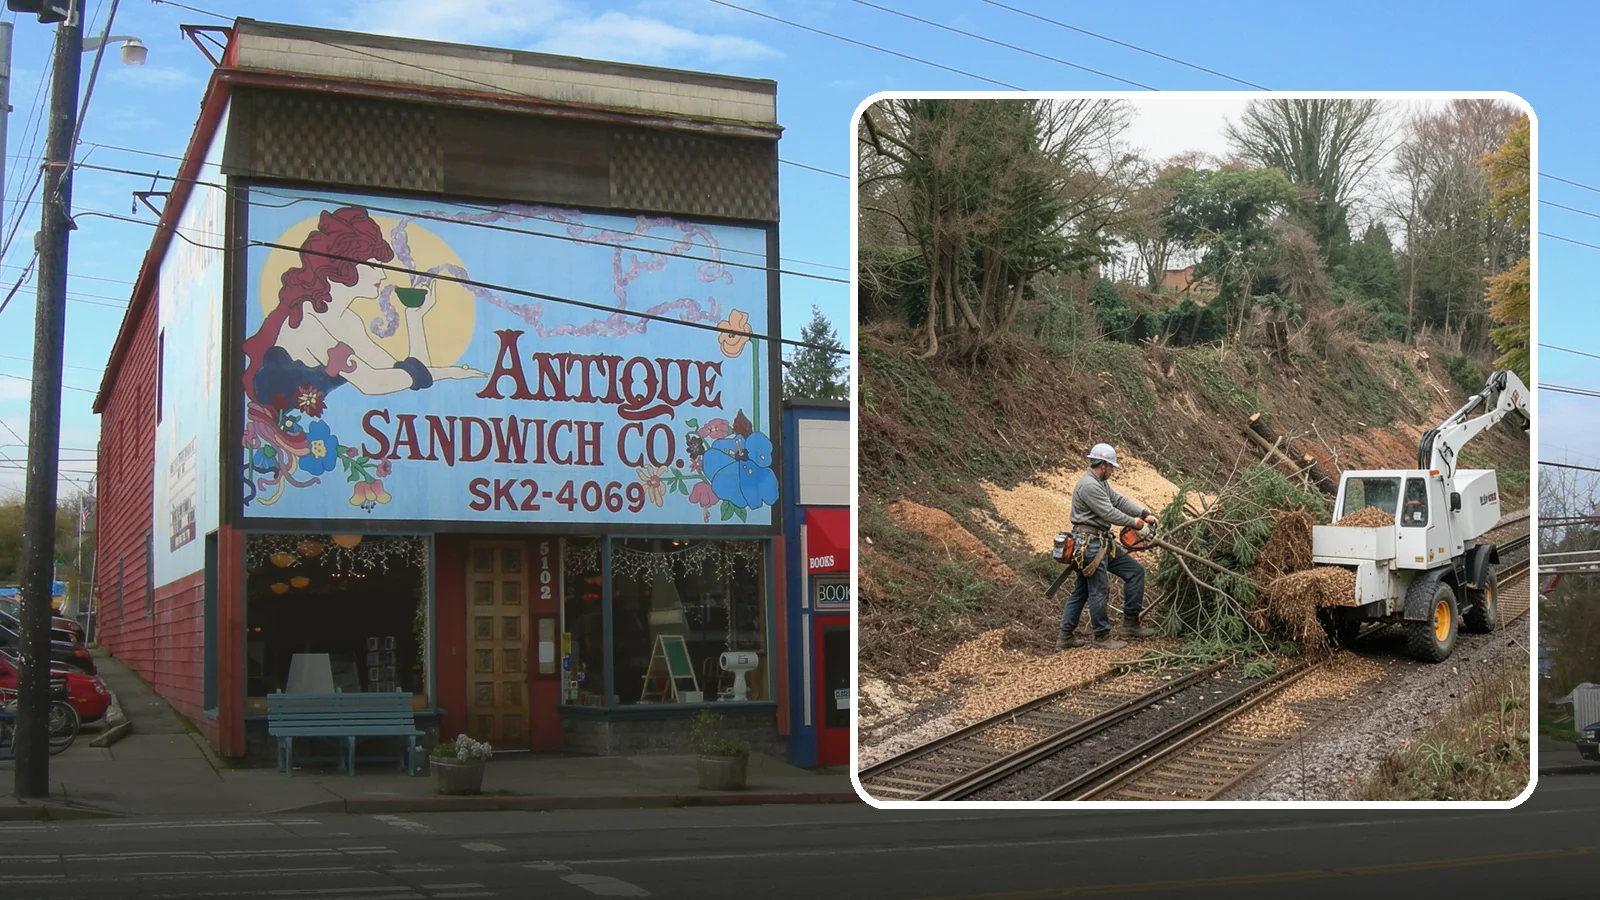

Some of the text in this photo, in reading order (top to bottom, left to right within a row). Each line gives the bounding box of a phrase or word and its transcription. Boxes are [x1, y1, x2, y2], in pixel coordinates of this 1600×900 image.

[476, 329, 724, 421] ANTIQUE
[361, 408, 685, 469] SANDWICH CO.
[468, 477, 645, 513] SK2-4069
[540, 541, 551, 600] 5102
[809, 554, 835, 569] BOOKS
